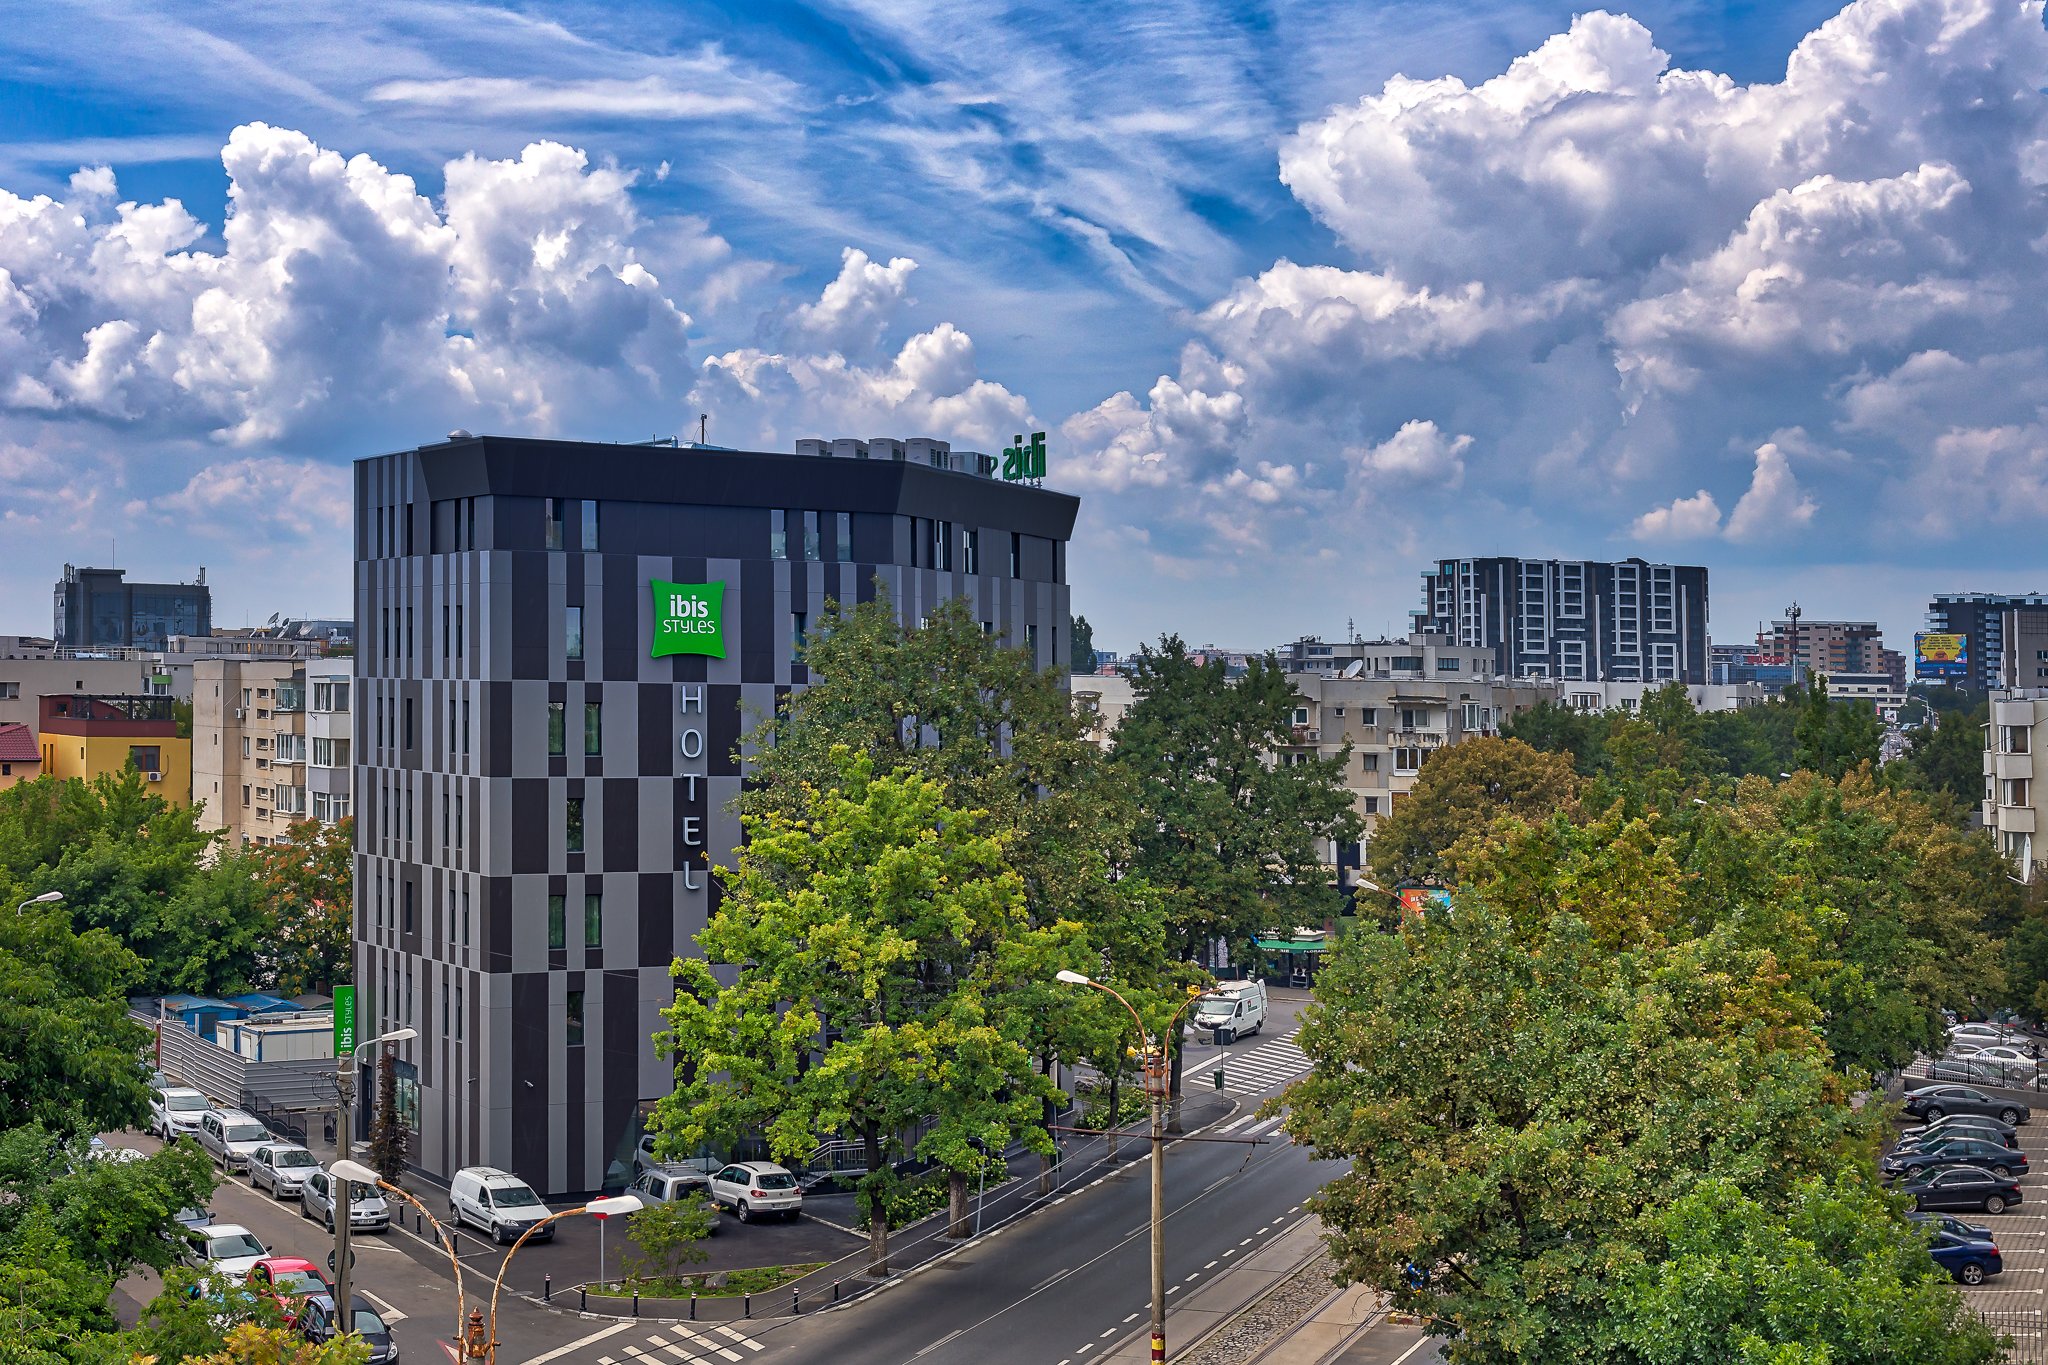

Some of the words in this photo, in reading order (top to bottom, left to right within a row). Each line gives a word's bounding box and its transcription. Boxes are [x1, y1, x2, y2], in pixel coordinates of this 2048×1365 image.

[670, 594, 709, 618] ibis
[680, 685, 703, 890] HOTEL
[340, 1027, 352, 1048] ibis
